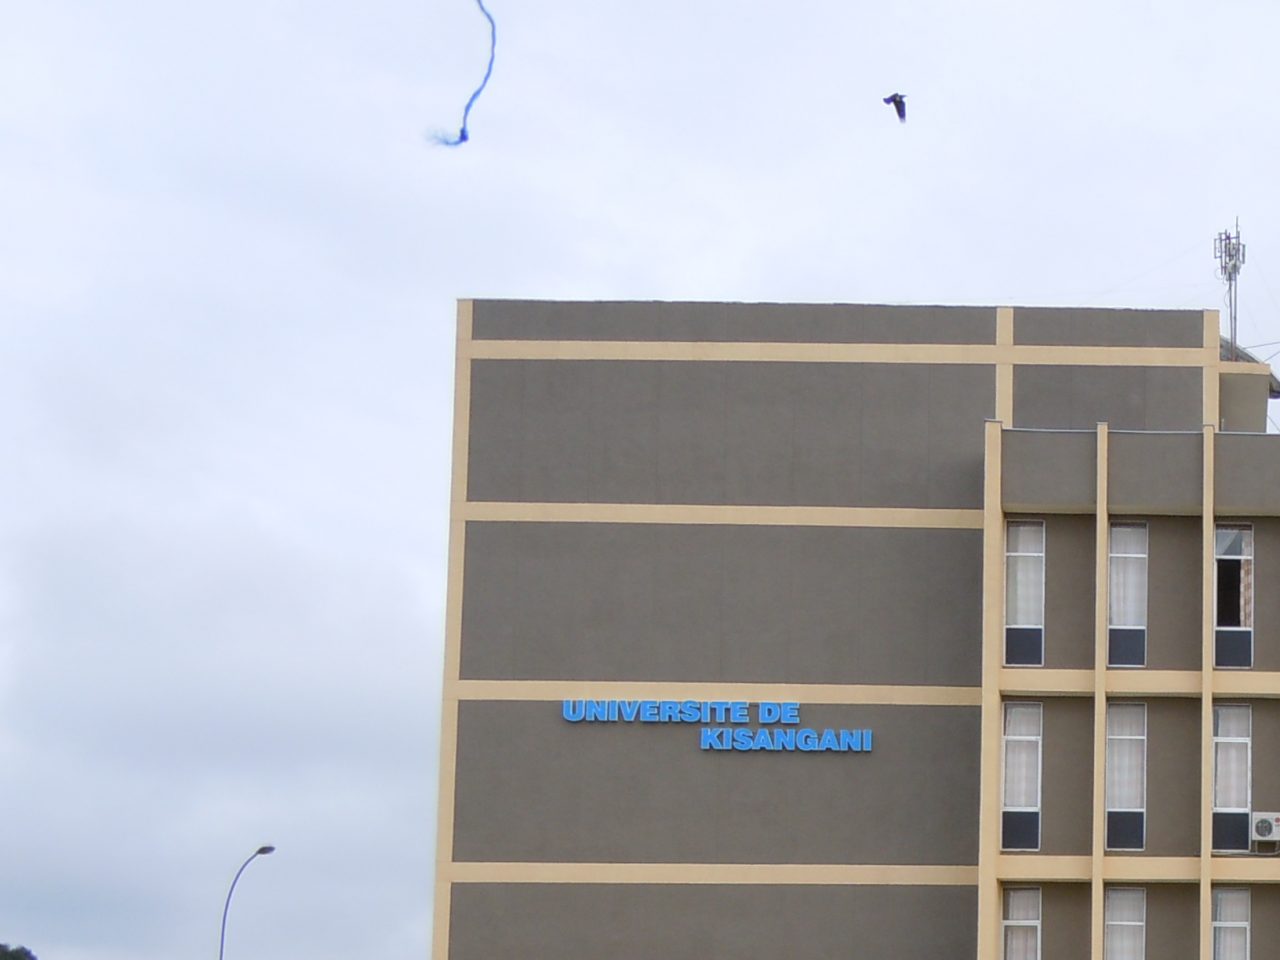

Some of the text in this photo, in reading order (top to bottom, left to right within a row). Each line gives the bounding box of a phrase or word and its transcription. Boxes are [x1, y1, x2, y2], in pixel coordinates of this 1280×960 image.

[562, 699, 799, 723] UNIVERSITE DE
[700, 727, 872, 751] KISANGANI
